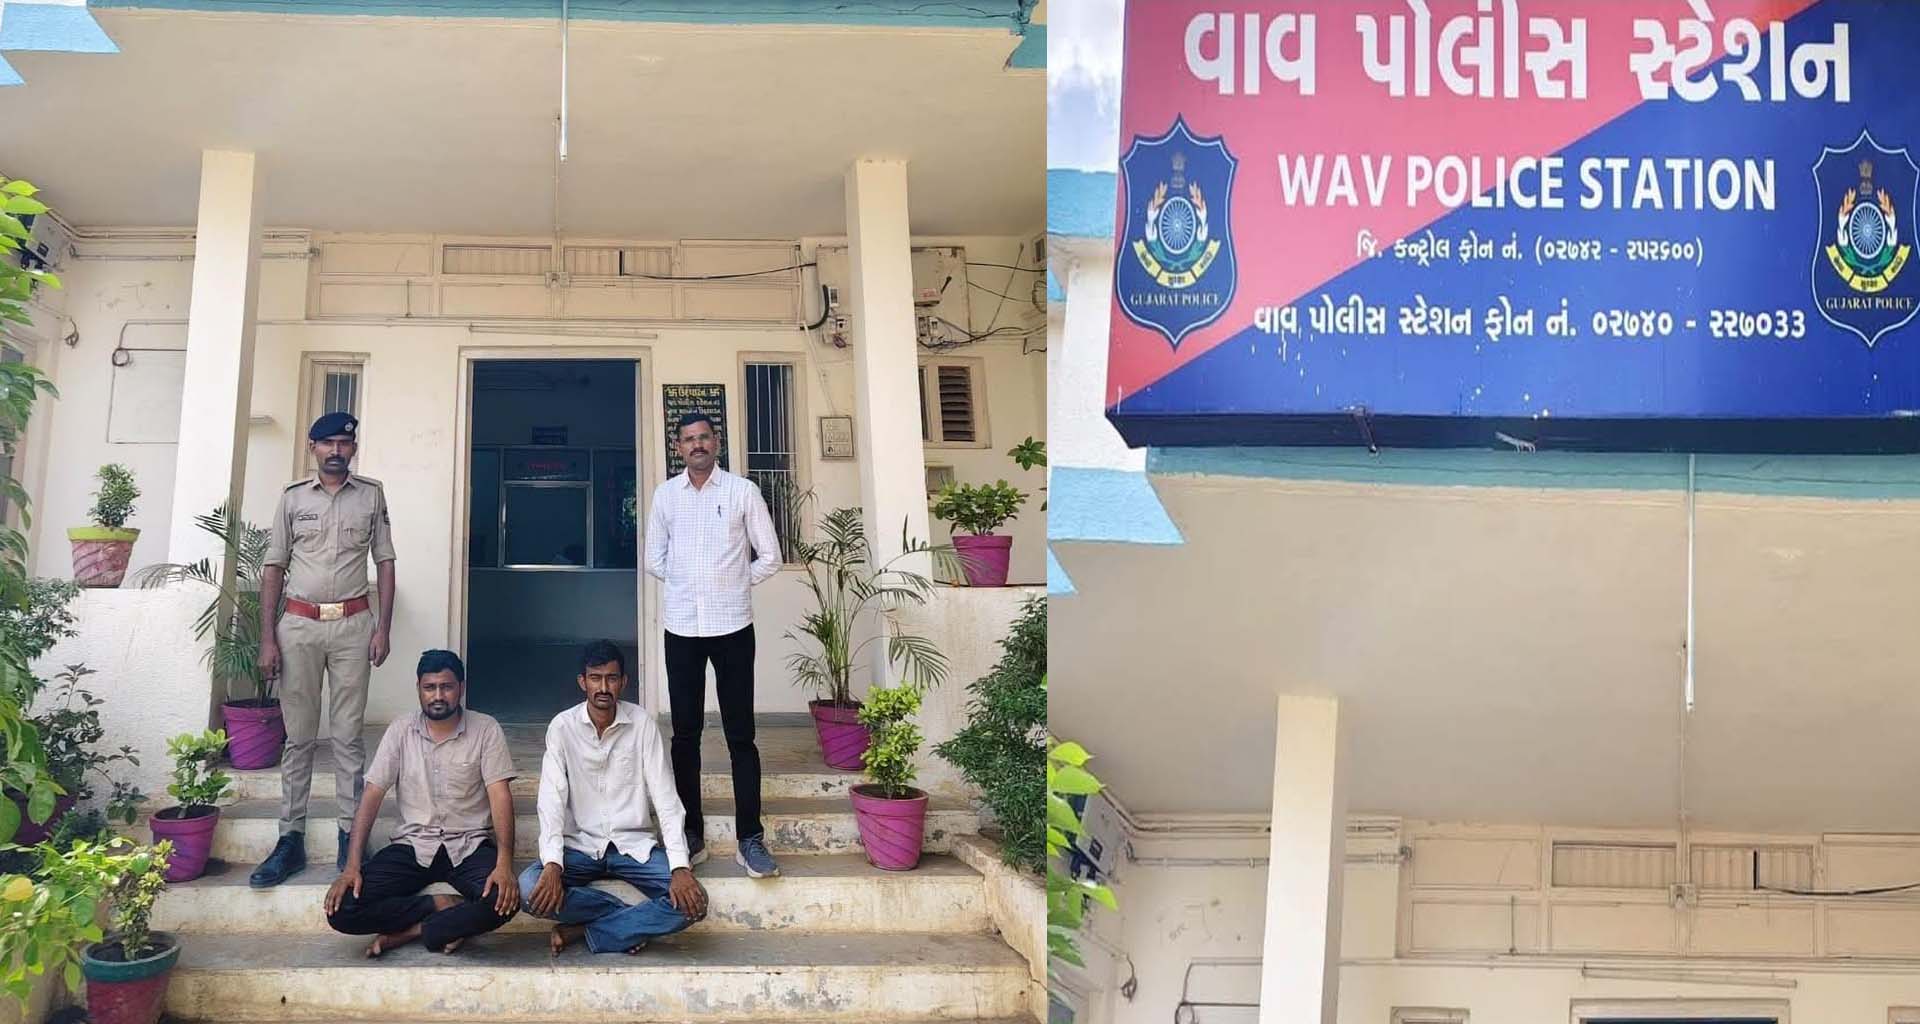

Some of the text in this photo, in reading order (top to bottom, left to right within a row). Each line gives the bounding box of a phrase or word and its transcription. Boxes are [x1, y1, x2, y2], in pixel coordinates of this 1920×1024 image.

[1183, 12, 1316, 96] વાવ
[1629, 0, 1851, 103] સ્ટેશન
[1277, 153, 1776, 211] WAV POLICE STATION
[1356, 229, 1383, 258] જિ.
[1458, 229, 1494, 266] ફોન
[1501, 231, 1523, 260] નં.
[1535, 234, 1602, 266] (૦૨૭૪૨
[1130, 292, 1219, 306] GUJARAT POLICE
[1253, 306, 1298, 334] વાવ
[1309, 293, 1386, 336] પોલીસ
[1398, 294, 1473, 337] સ્ટેશન
[1484, 295, 1535, 341] ફોન
[1545, 297, 1578, 337] નં.
[1592, 310, 1674, 338] ૦૨૭૪૦
[1709, 309, 1806, 338] ૨૨૭૦૩૩
[1825, 296, 1911, 310] GUJARAT POLICE
